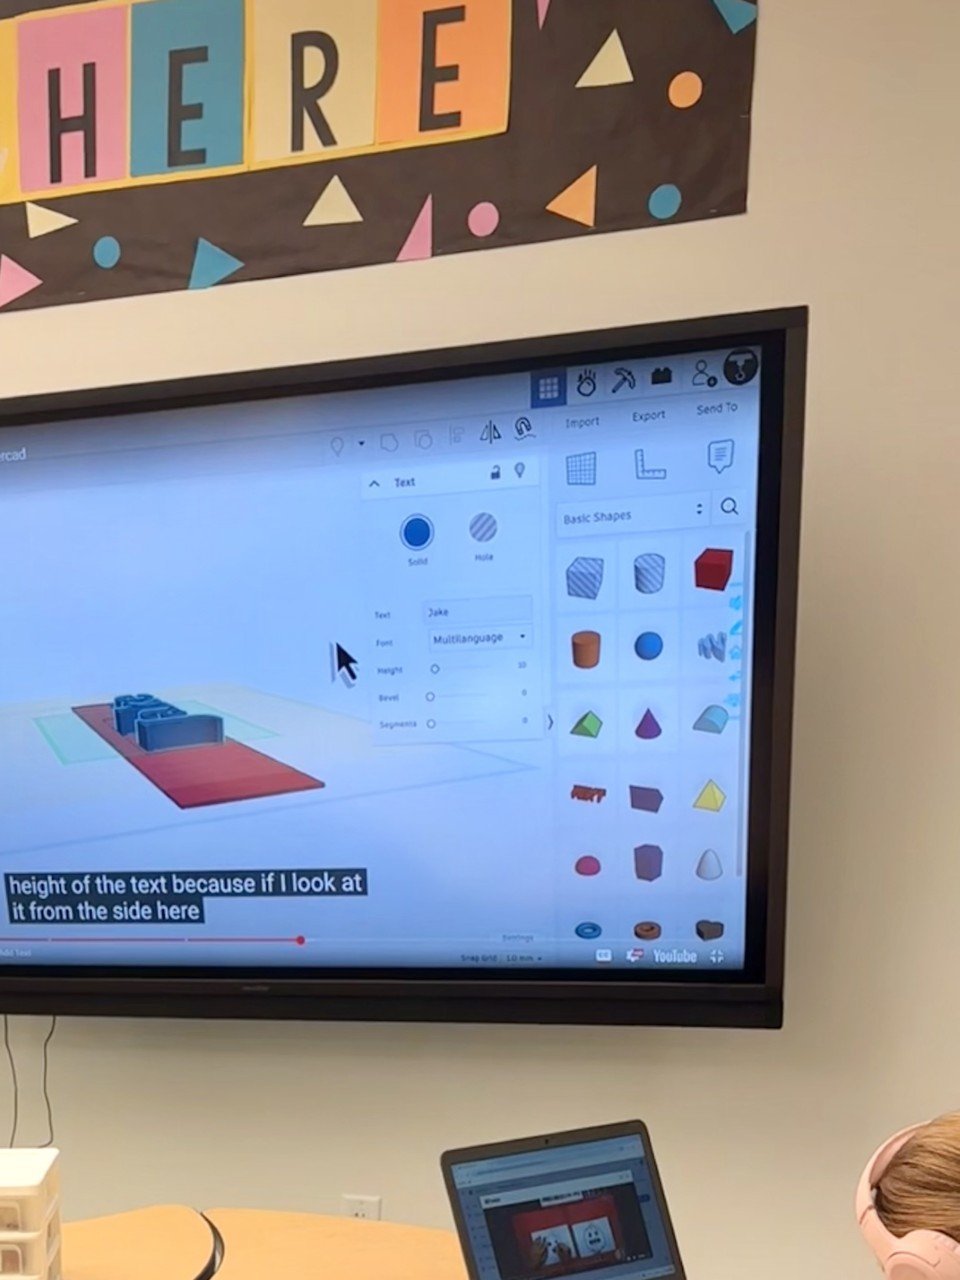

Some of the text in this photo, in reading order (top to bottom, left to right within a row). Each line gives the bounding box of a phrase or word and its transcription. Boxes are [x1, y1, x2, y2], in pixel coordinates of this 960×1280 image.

[47, 7, 466, 184] HERE
[697, 402, 738, 416] Send To
[632, 410, 667, 423] Export
[565, 417, 600, 430] Import
[394, 478, 416, 488] Text
[563, 511, 632, 525] Basic Shapes
[408, 558, 428, 567] Solid
[475, 553, 494, 562] Hole
[427, 607, 449, 618] Jake
[433, 632, 504, 647] Multilanguage
[377, 665, 404, 677] Height
[9, 872, 363, 899] height of the text because if I look at
[12, 900, 201, 921] it from the side here
[653, 949, 698, 963] YouTube
